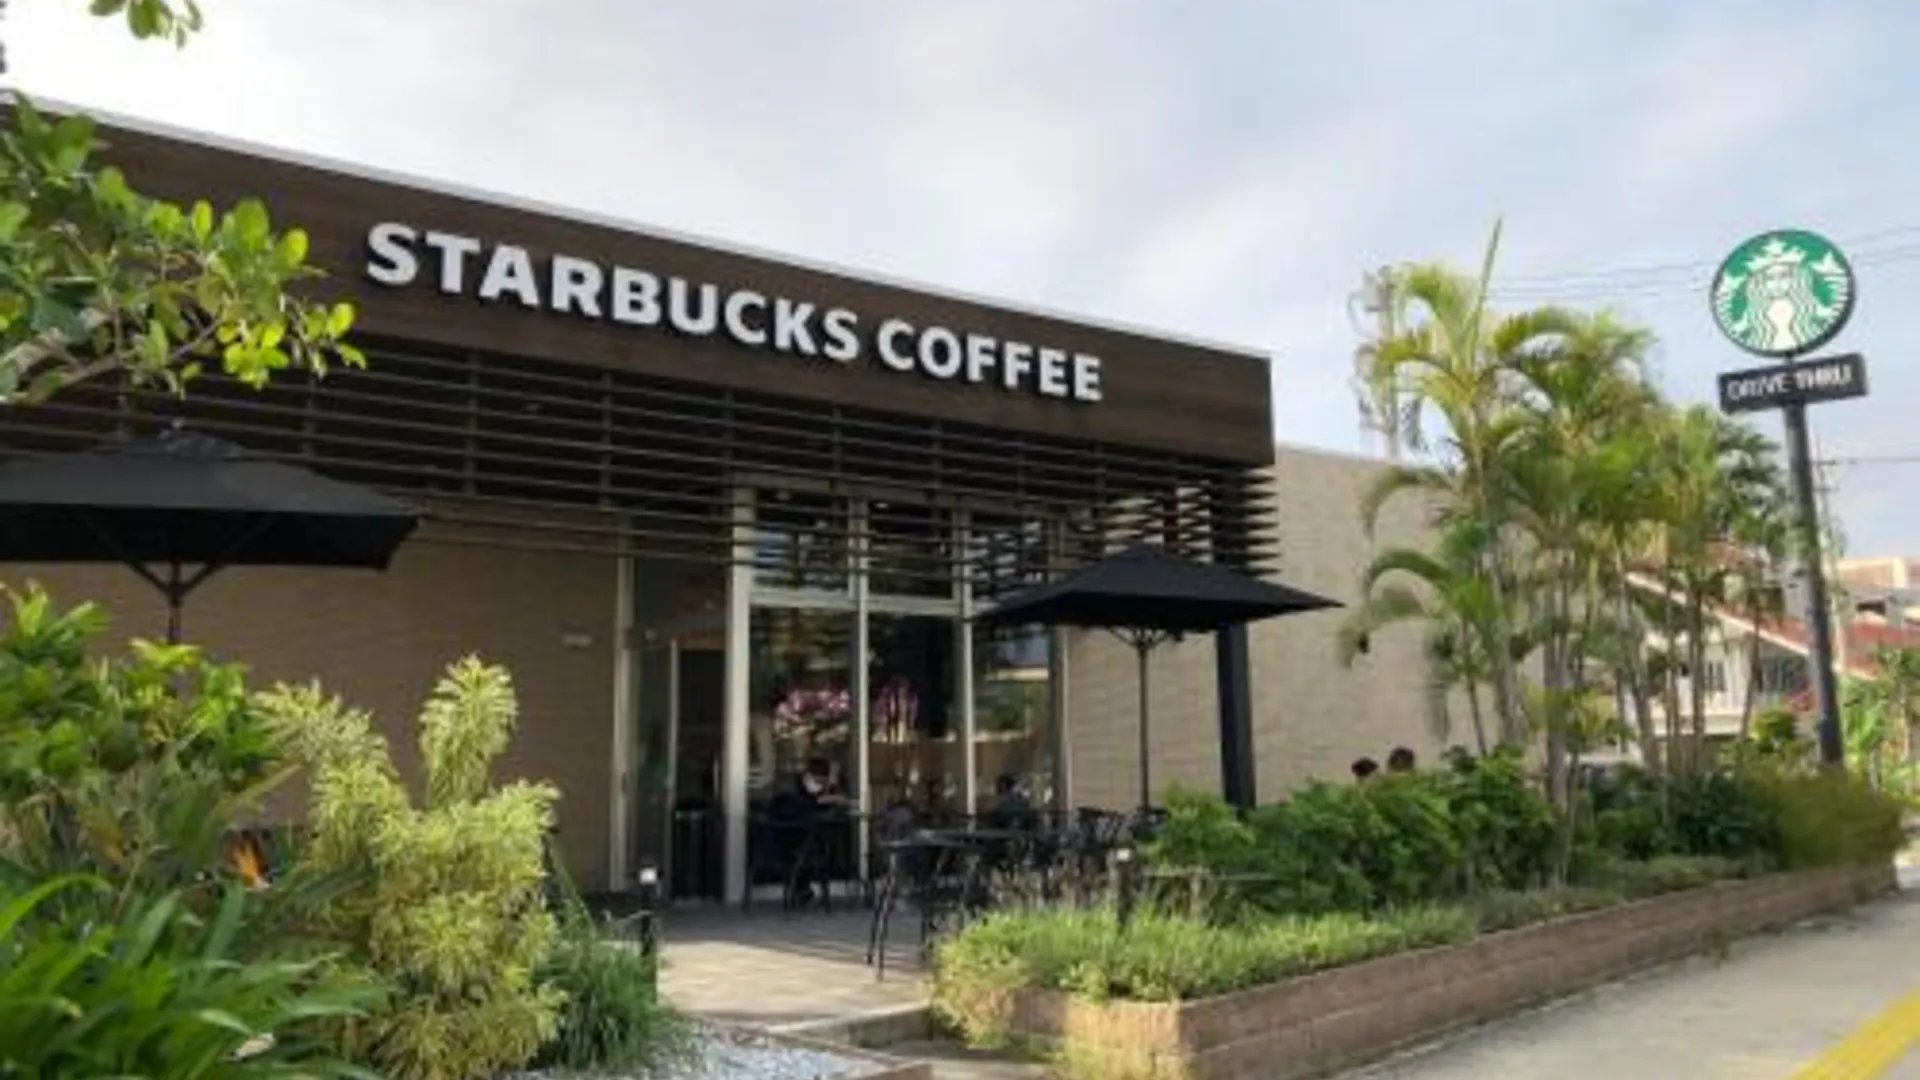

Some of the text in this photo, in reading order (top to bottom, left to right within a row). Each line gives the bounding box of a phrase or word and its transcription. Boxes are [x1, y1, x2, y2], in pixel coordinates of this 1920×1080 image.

[366, 222, 1103, 401] STARBUCKS COFFEE
[1726, 363, 1852, 399] DRIVE THRU
